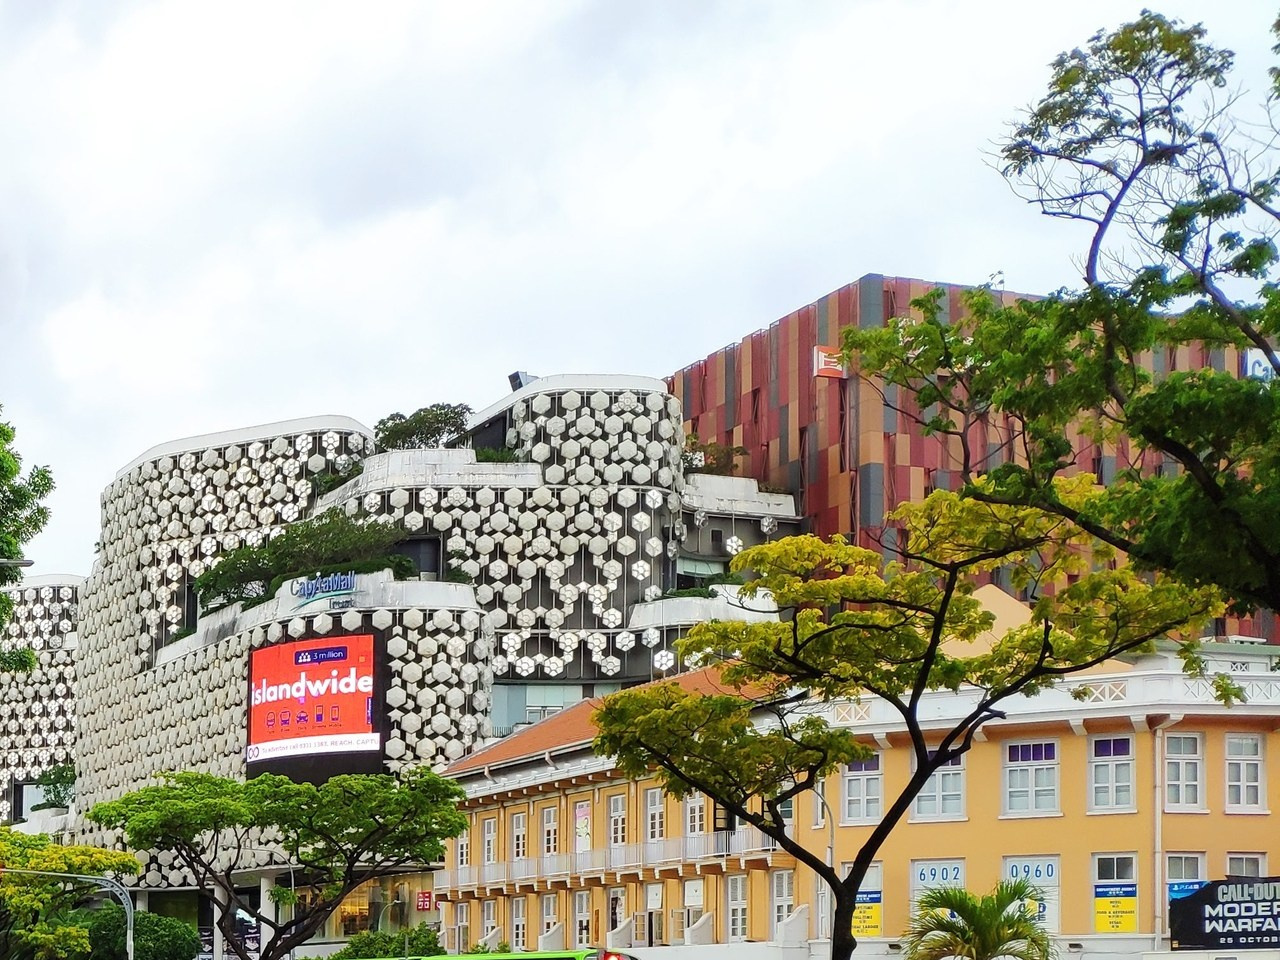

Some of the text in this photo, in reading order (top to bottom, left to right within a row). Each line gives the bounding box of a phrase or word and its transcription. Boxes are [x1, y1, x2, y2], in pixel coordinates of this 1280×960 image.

[313, 650, 344, 660] 3 million
[251, 667, 373, 706] islandwide
[919, 866, 960, 882] 6902
[1010, 863, 1055, 879] 0960
[1217, 883, 1250, 902] CALL
[1204, 917, 1280, 933] WARFA
[1239, 936, 1280, 944] OCTOB
